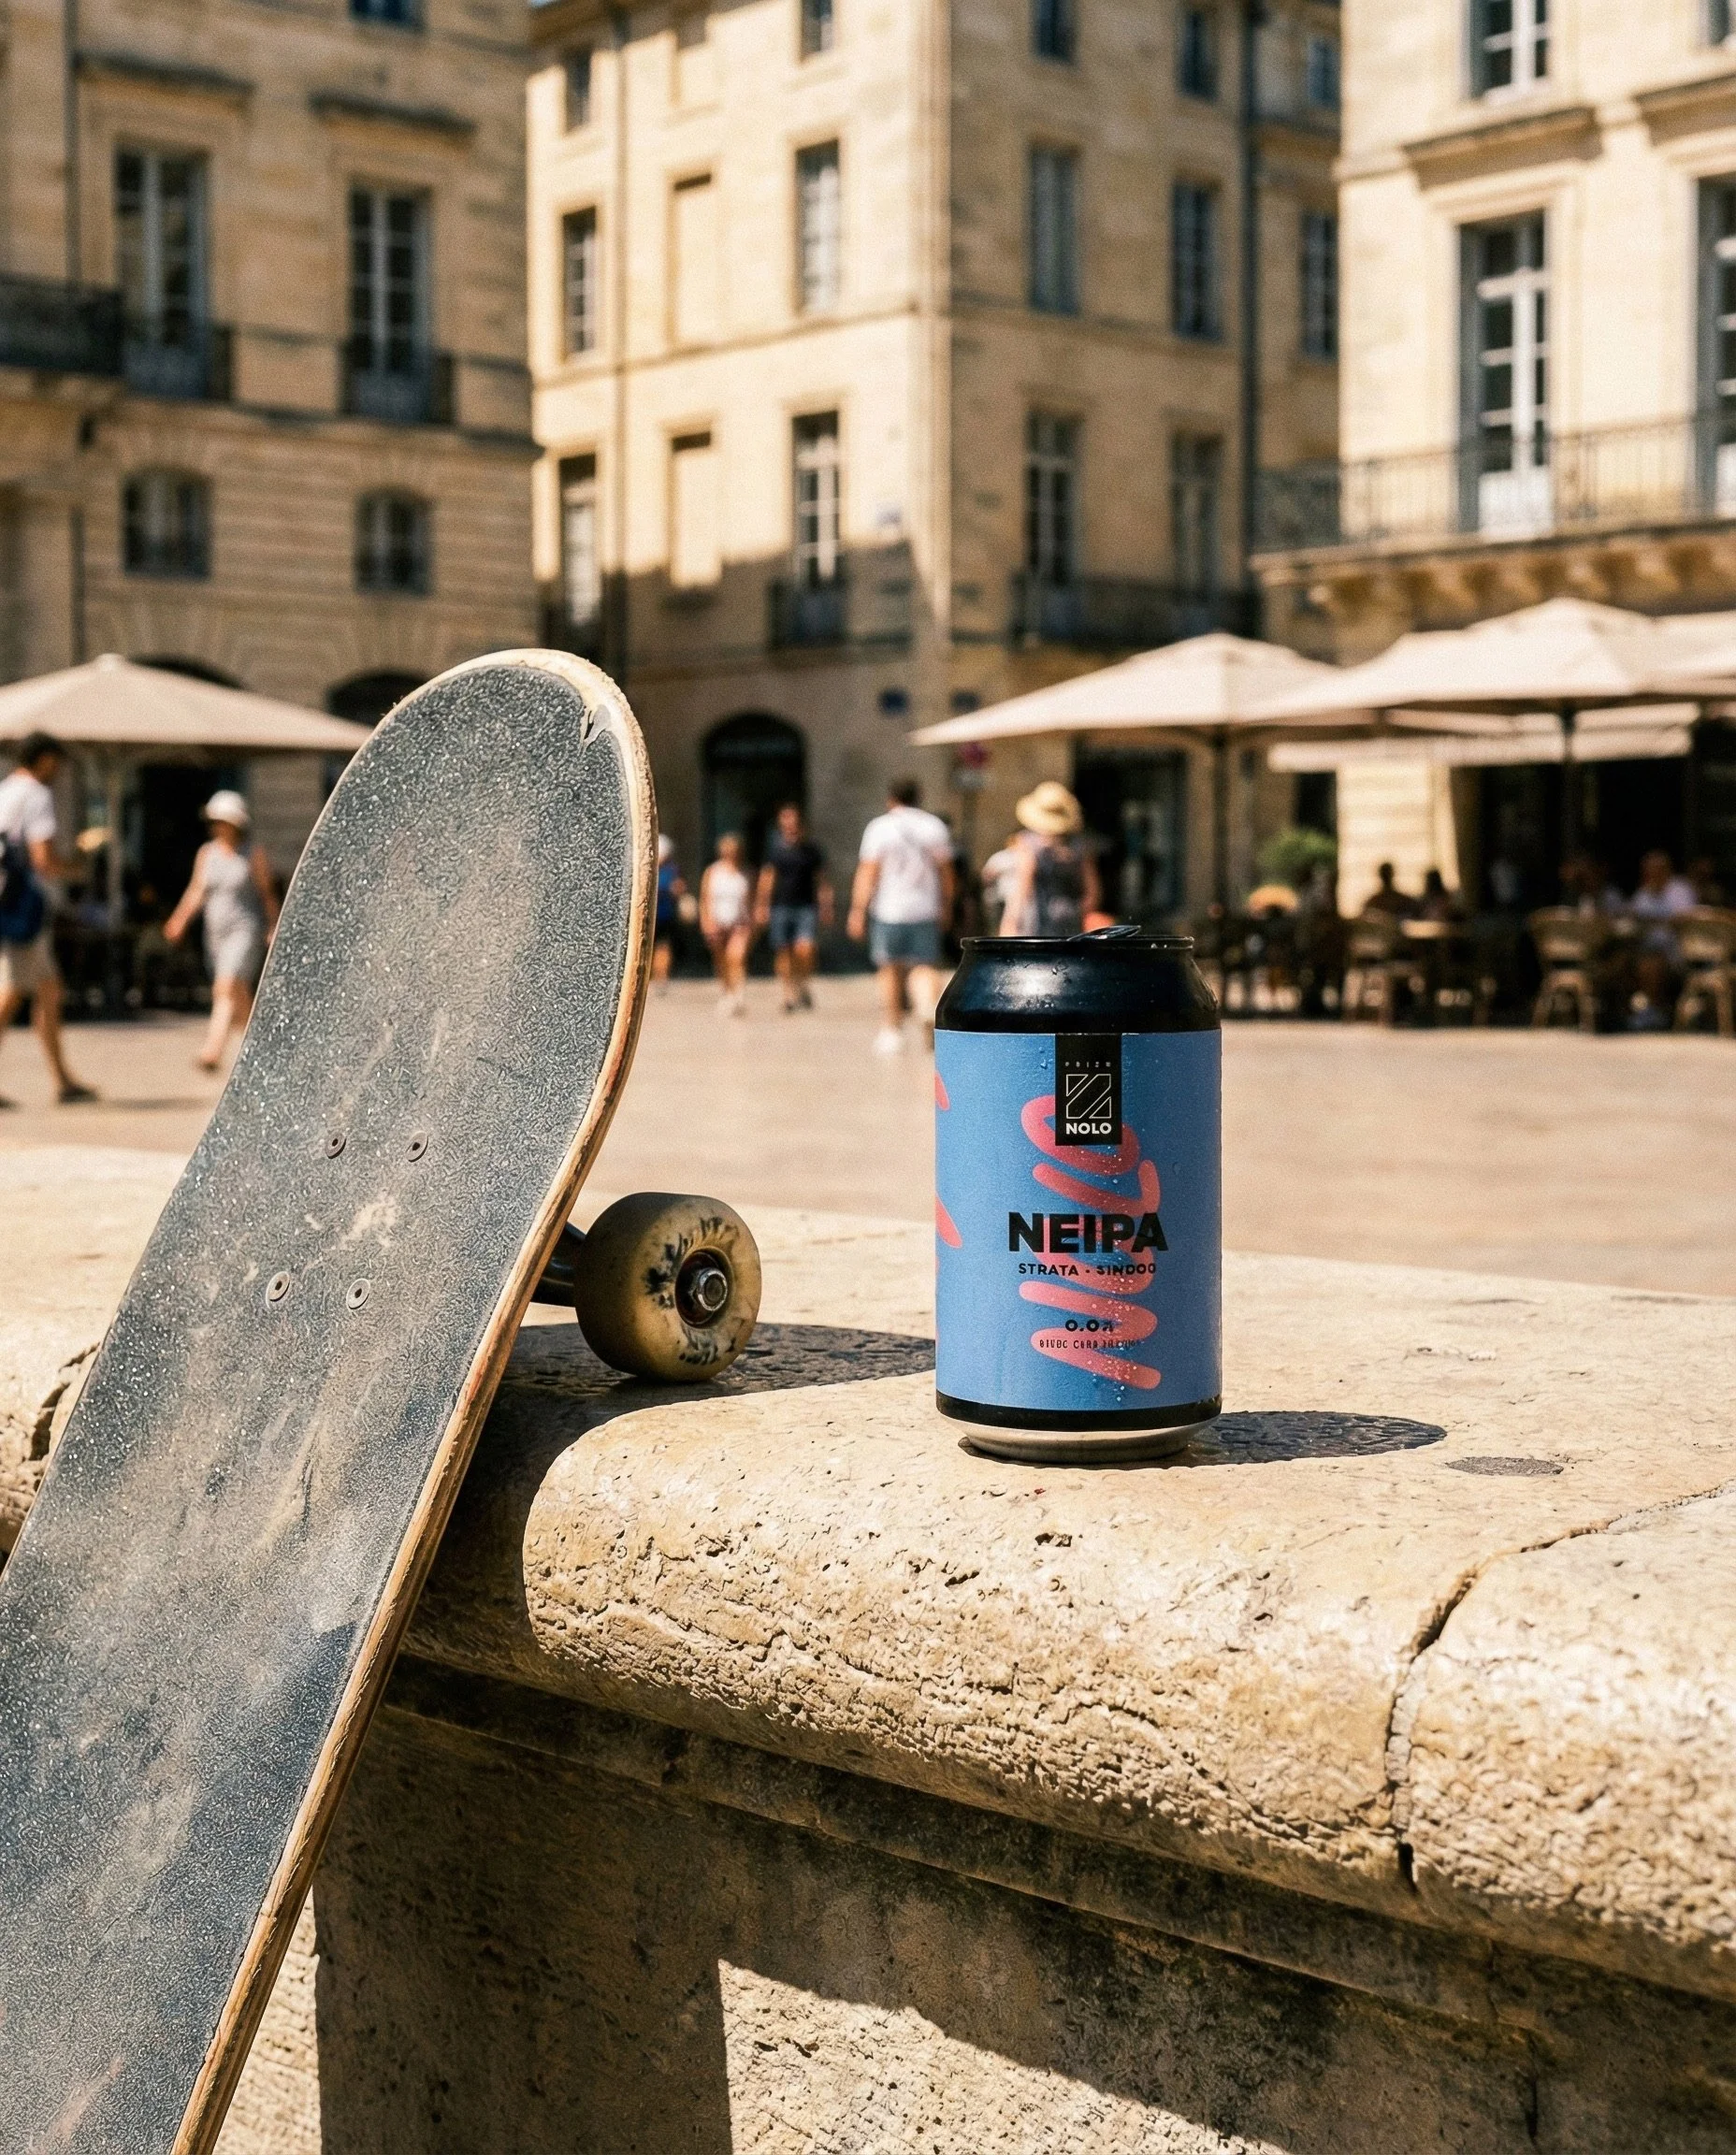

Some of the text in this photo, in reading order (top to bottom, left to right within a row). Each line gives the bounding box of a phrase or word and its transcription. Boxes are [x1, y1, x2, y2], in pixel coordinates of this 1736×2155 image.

[1065, 1122, 1112, 1135] NOLO
[1008, 1211, 1169, 1253] NEIPA
[1019, 1264, 1078, 1276] STRATA
